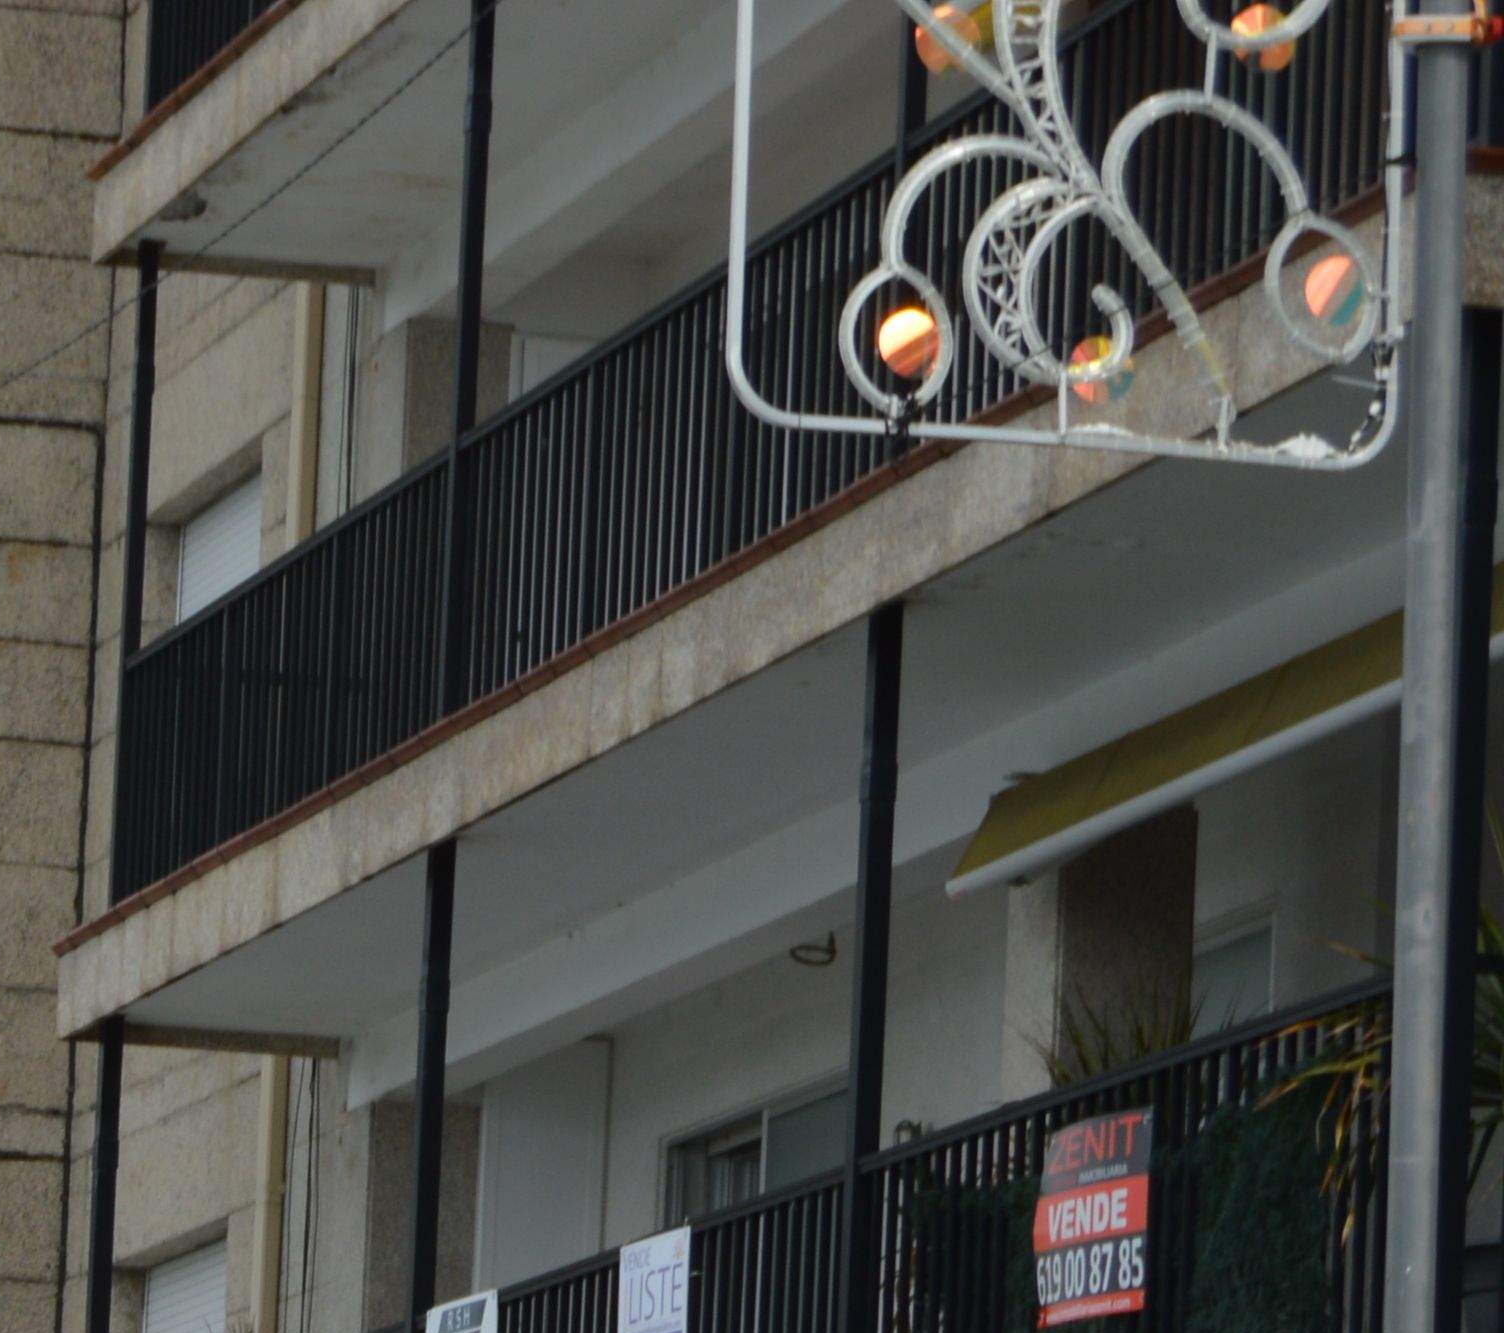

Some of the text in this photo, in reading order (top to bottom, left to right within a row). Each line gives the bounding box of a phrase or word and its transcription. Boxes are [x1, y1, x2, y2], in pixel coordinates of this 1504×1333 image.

[1049, 1113, 1142, 1174] ZENIT
[1048, 1188, 1127, 1242] VENDE
[1037, 1237, 1144, 1307] 619 00 87 85
